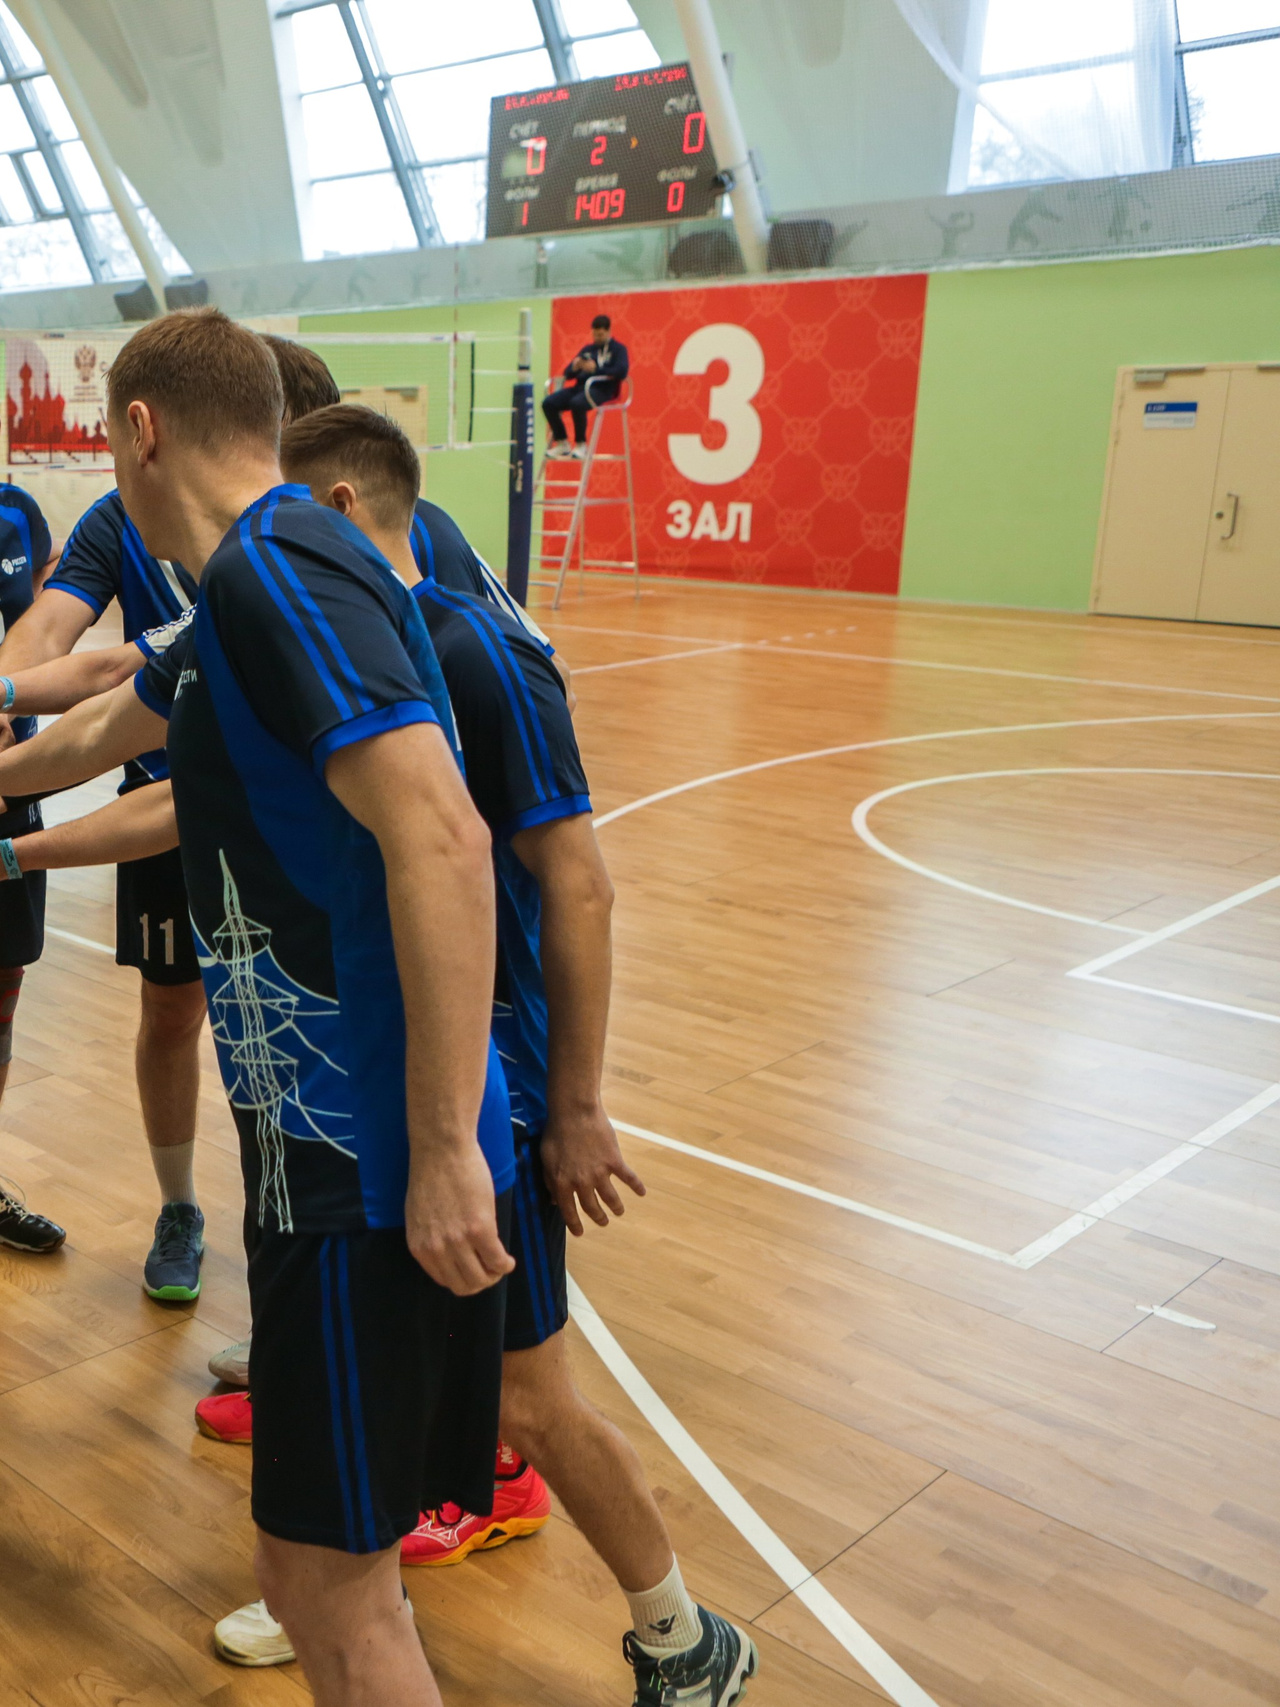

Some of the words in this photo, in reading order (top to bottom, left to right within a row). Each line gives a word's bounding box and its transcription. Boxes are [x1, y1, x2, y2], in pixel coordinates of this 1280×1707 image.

[590, 135, 607, 166] 2
[682, 112, 706, 154] 0
[522, 201, 529, 226] 1
[667, 181, 685, 213] 0
[668, 322, 765, 486] 3
[665, 500, 753, 543] ЗАЛ
[139, 912, 175, 966] 11
